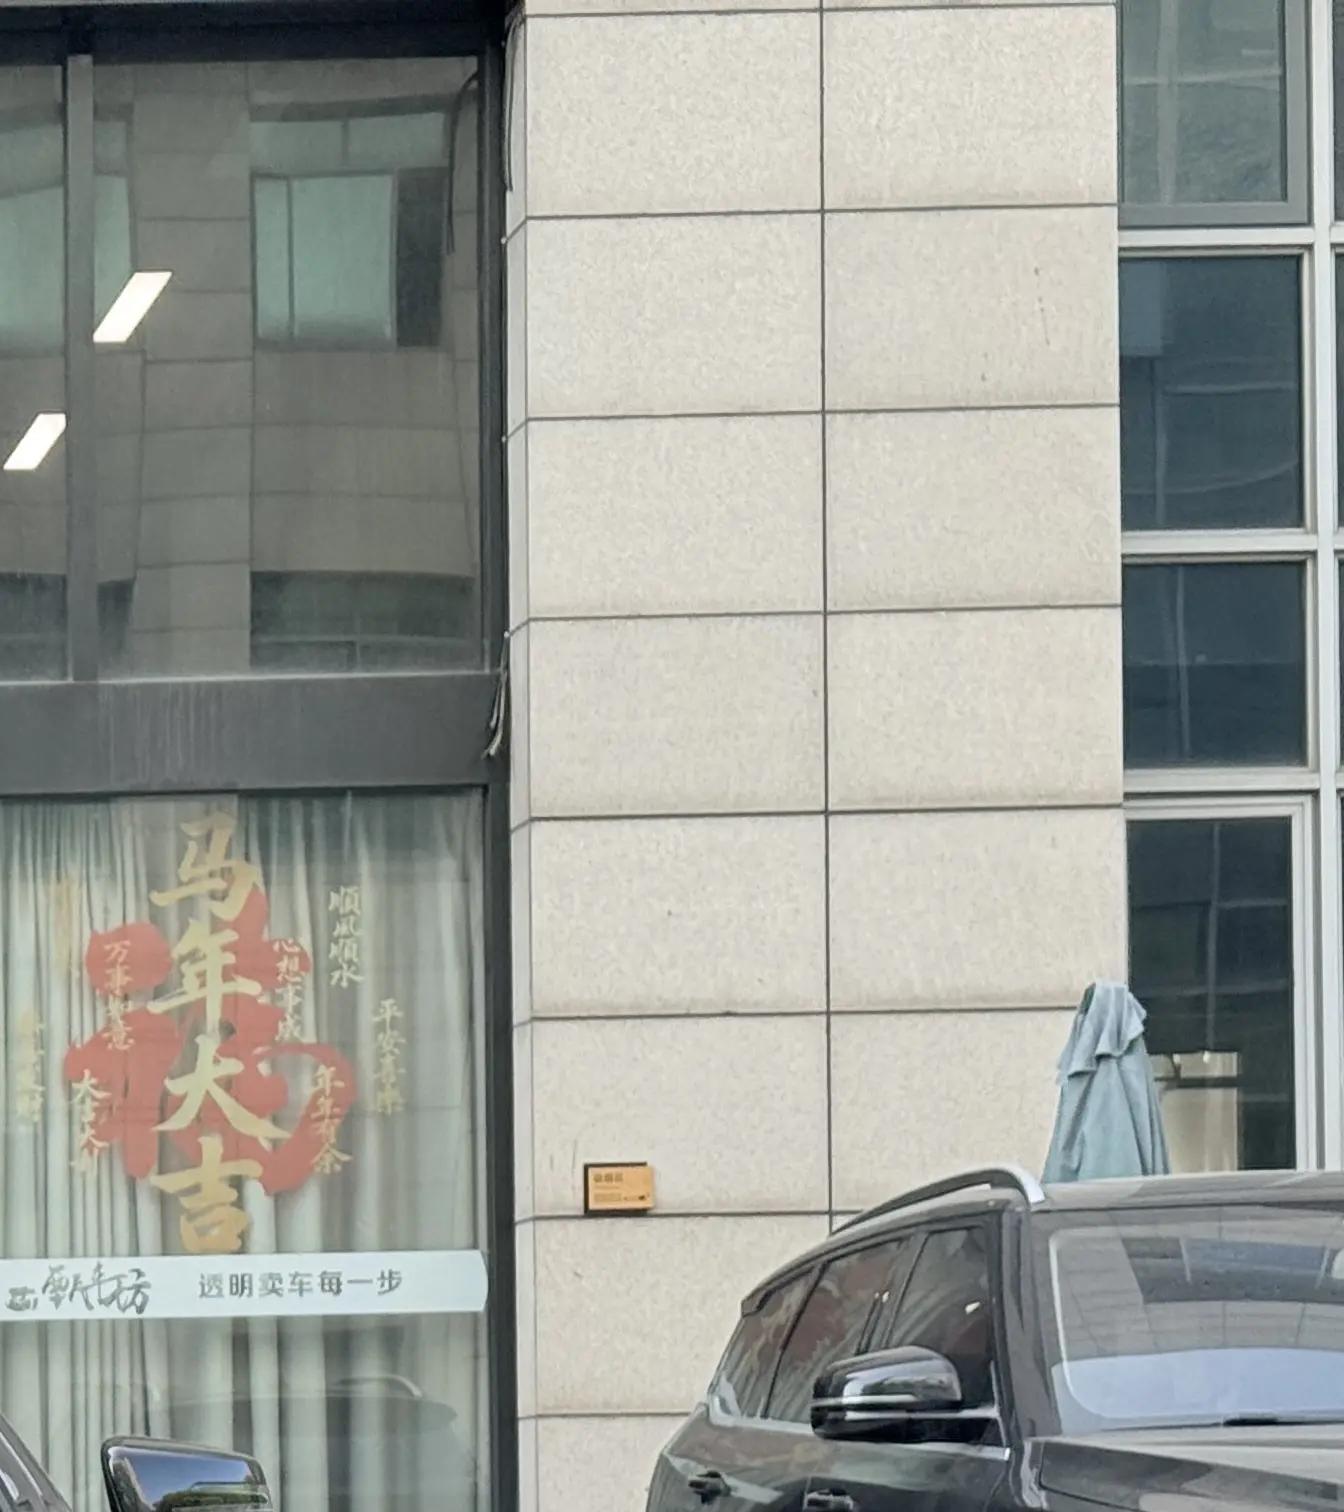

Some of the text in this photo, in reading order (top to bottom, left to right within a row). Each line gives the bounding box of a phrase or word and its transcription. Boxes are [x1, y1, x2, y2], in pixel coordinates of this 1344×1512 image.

[150, 811, 292, 1253] 马年大吉
[198, 1268, 403, 1300] 透明卖车每一步
